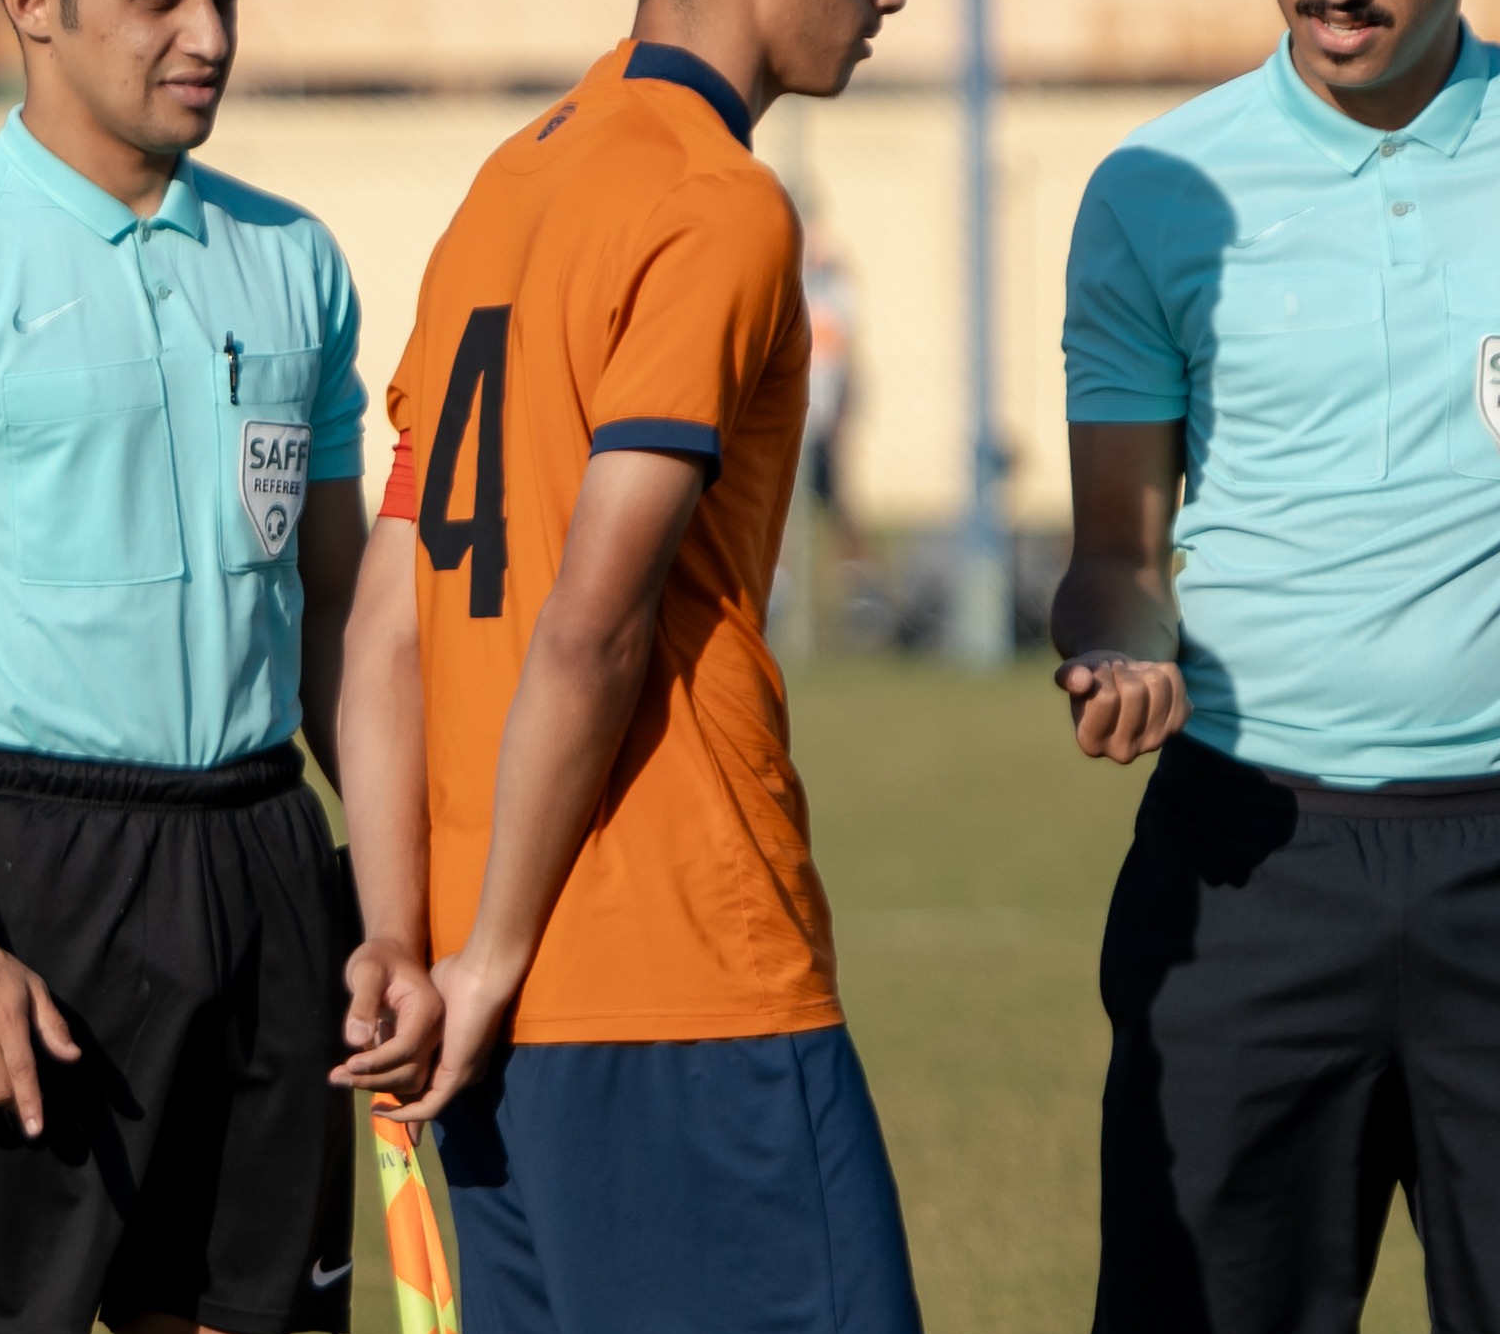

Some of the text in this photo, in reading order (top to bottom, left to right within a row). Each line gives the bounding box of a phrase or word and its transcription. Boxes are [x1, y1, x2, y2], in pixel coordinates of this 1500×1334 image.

[249, 437, 308, 471] SAFF
[419, 302, 513, 619] 4
[254, 478, 301, 495] REFEREE
